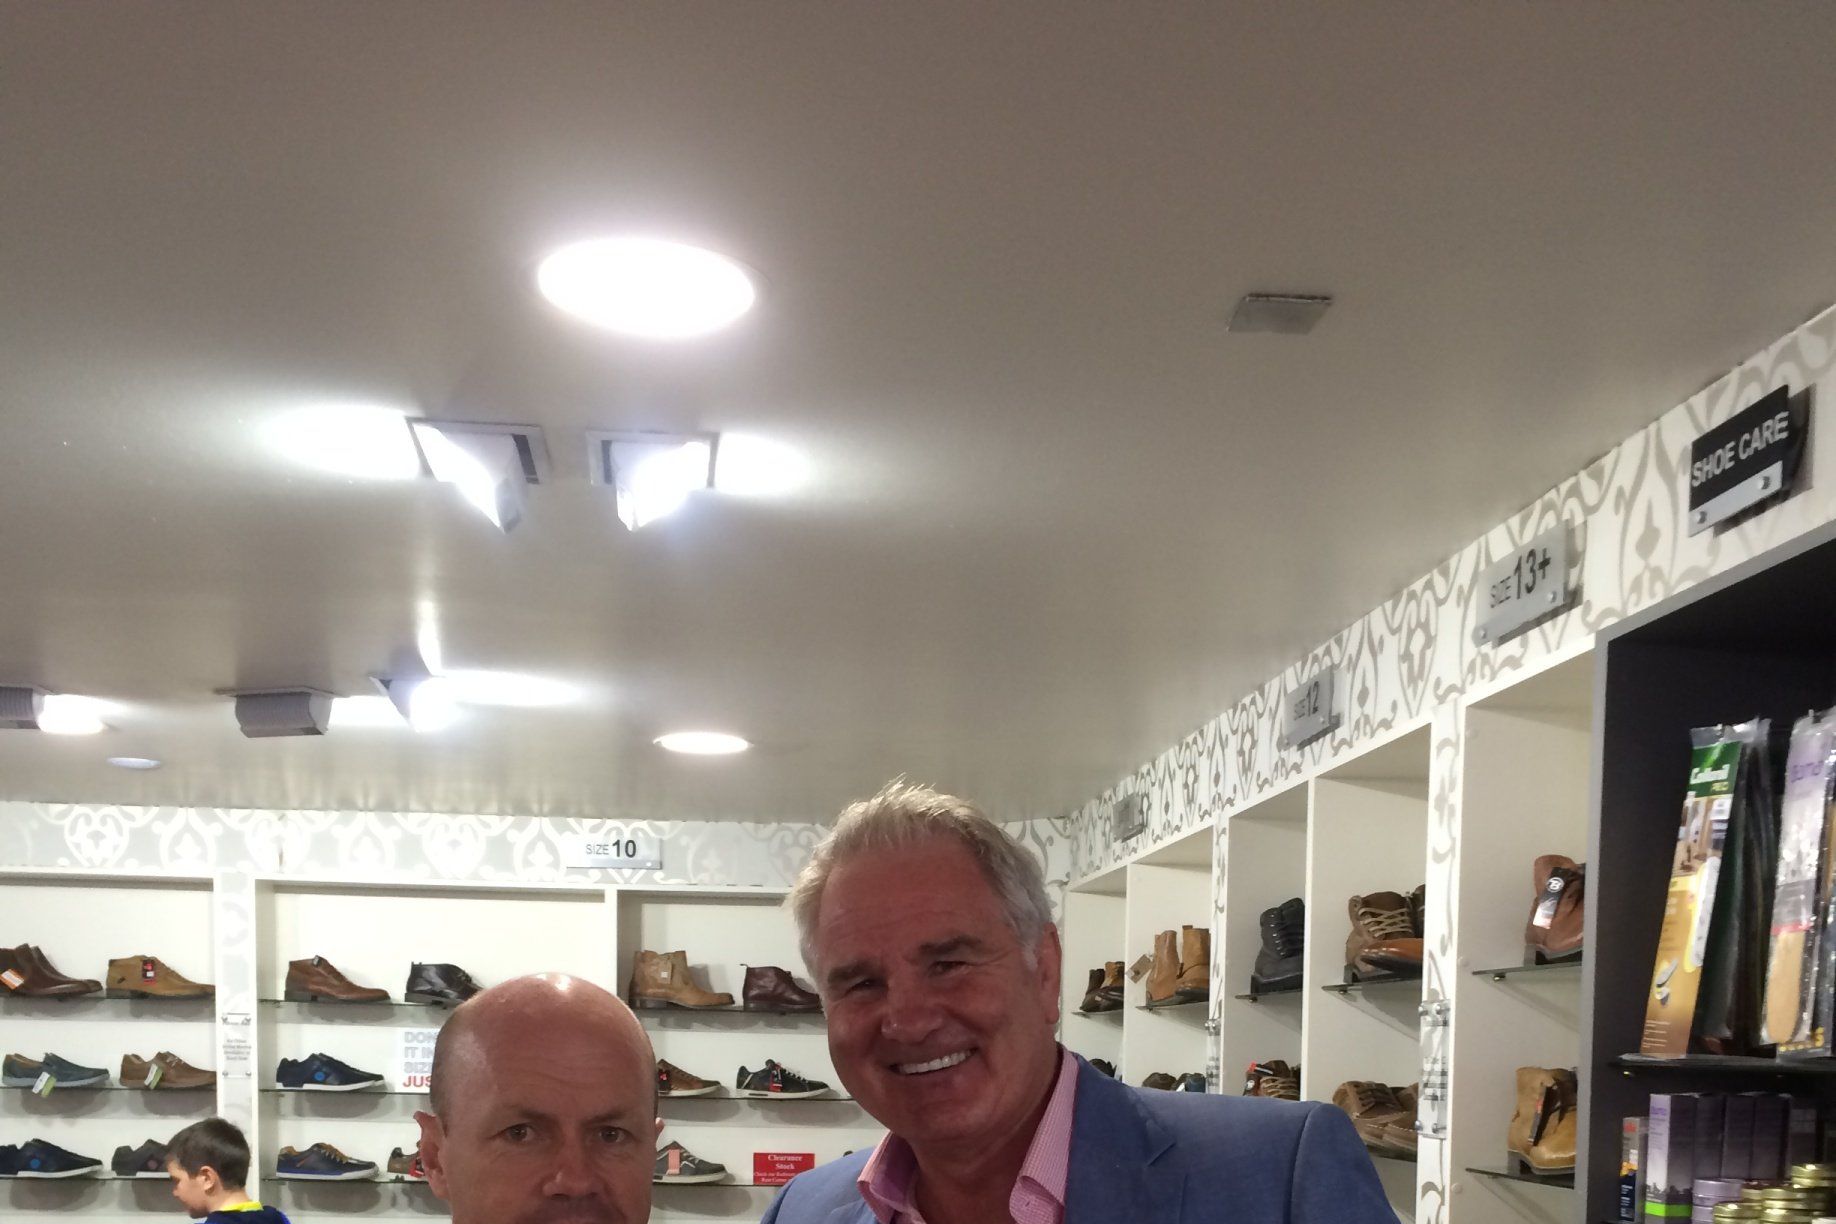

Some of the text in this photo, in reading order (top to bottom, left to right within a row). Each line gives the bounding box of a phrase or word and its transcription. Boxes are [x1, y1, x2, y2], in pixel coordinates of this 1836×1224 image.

[1691, 411, 1789, 487] SHOE CARE
[1514, 547, 1552, 600] 13+
[1306, 680, 1319, 717] 12
[585, 839, 637, 858] SIZE 10
[404, 1031, 438, 1044] DON
[404, 1046, 418, 1059] IT
[404, 1061, 433, 1074] SIZ
[402, 1075, 432, 1088] JUS
[768, 1154, 802, 1162] Clearance
